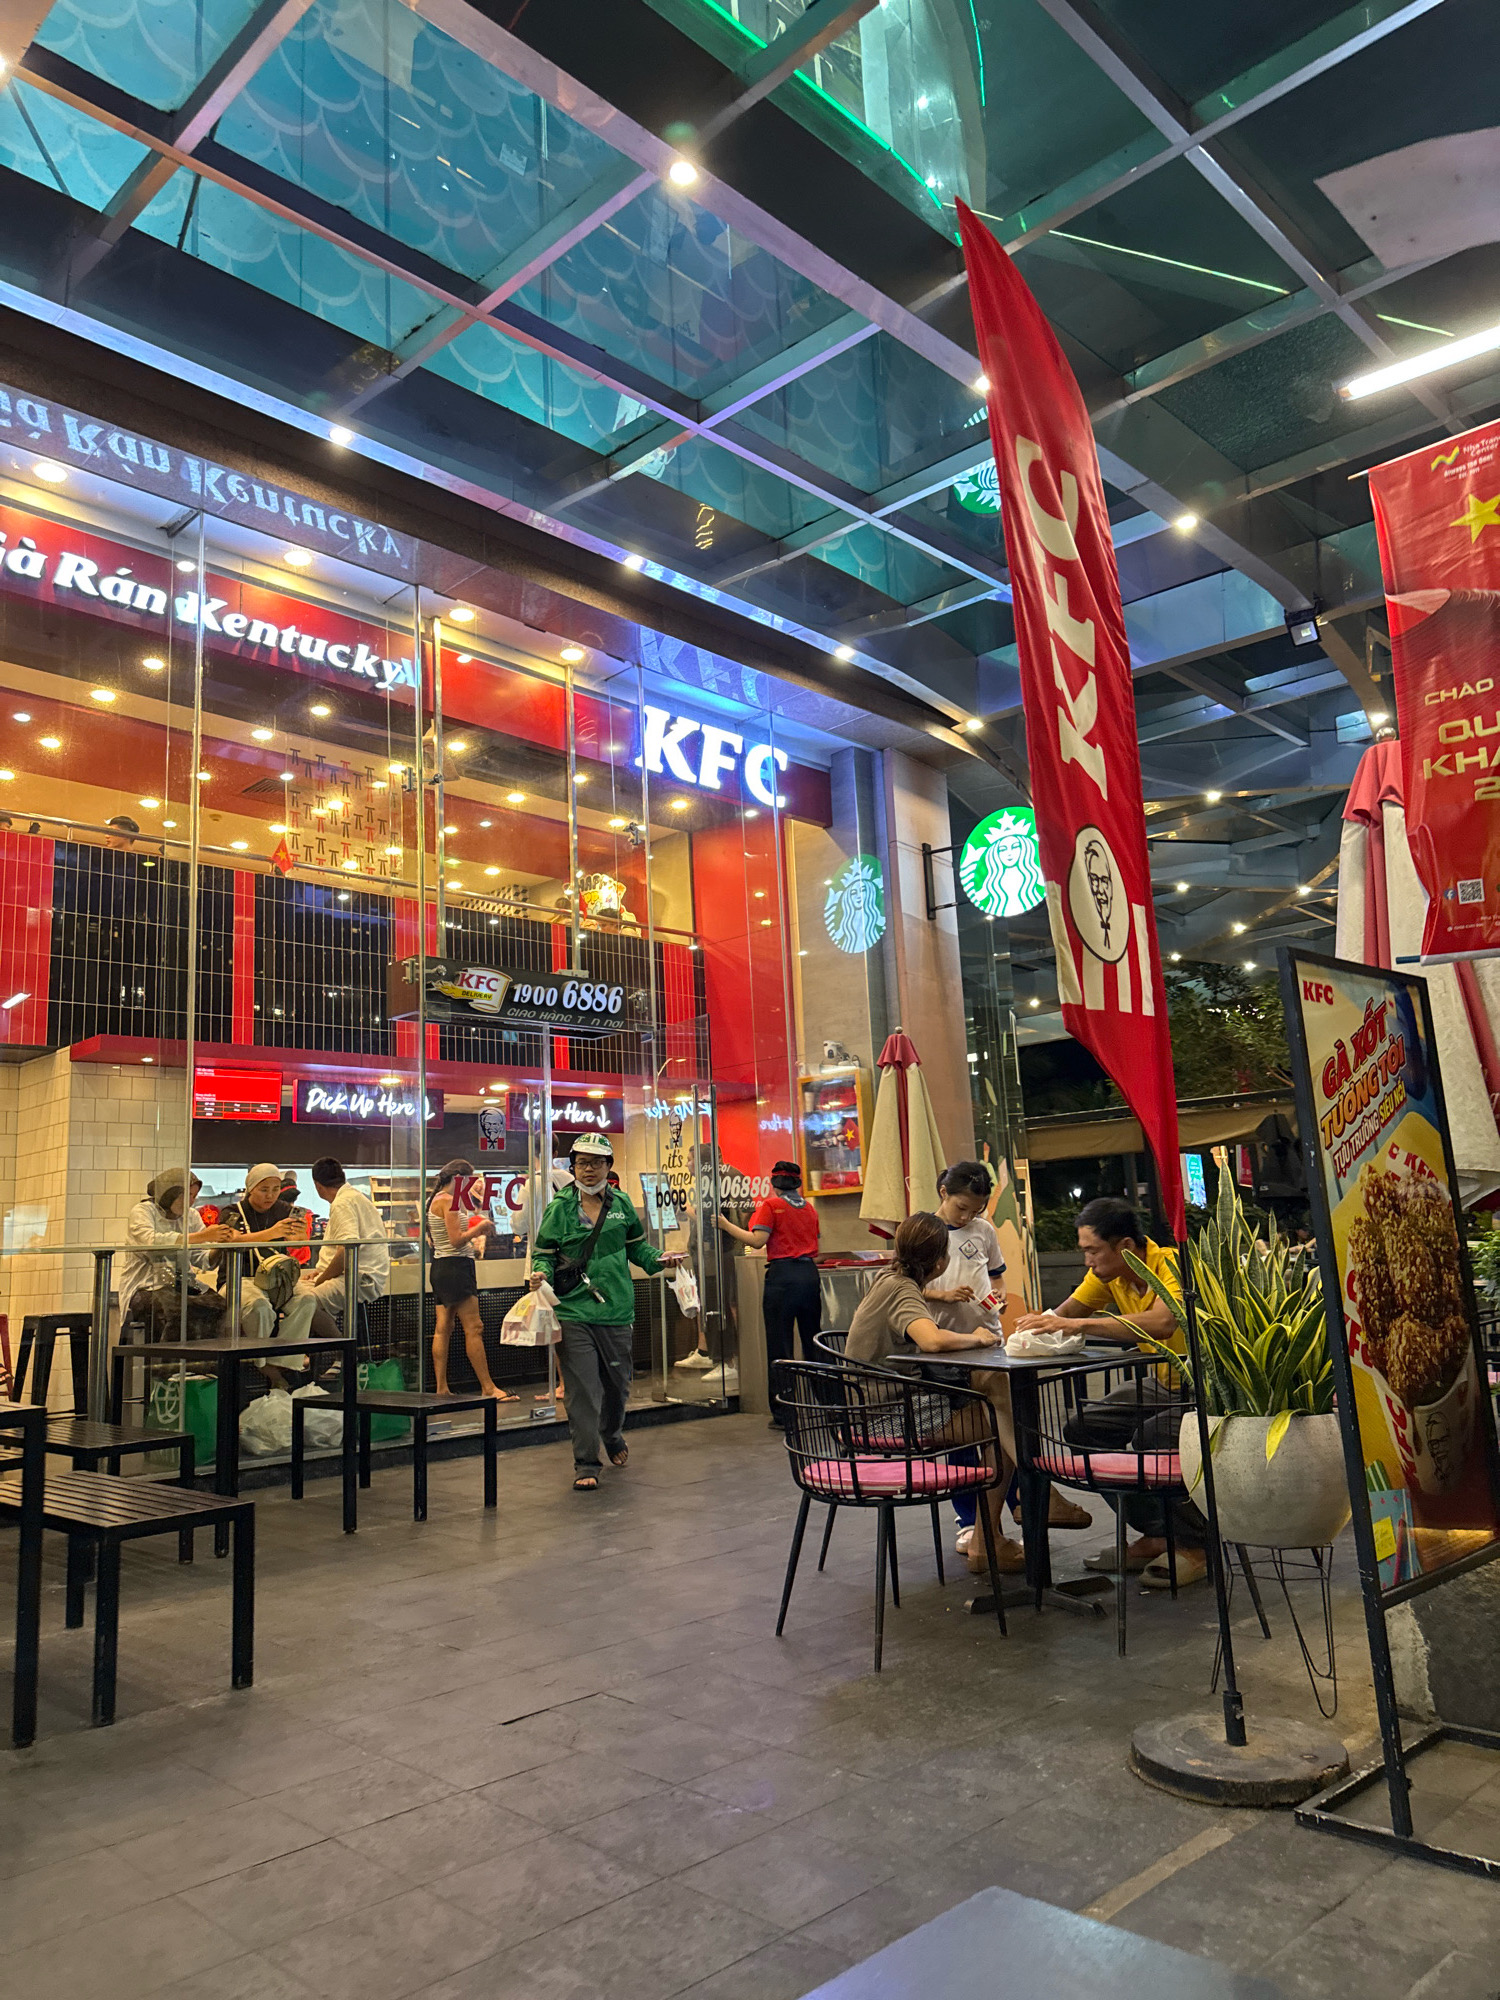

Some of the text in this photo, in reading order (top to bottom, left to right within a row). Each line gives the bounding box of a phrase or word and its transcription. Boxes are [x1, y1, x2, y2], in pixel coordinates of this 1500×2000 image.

[53, 551, 168, 615] Rán
[180, 591, 402, 691] Kentucky
[1015, 433, 1107, 801] KFC
[635, 705, 788, 808] KFC
[458, 973, 499, 992] KFC
[514, 980, 624, 1014] 1900 6886
[1303, 980, 1334, 1005] KFC
[507, 1007, 537, 1018] GIAO
[1322, 1038, 1354, 1100] GÀ
[306, 1087, 415, 1118] Pick Up Here
[564, 1101, 595, 1123] Here
[1320, 1062, 1380, 1150] TƯƠNG
[667, 1149, 684, 1168] it's
[449, 1176, 526, 1211] KFC
[606, 1211, 626, 1220] Grab
